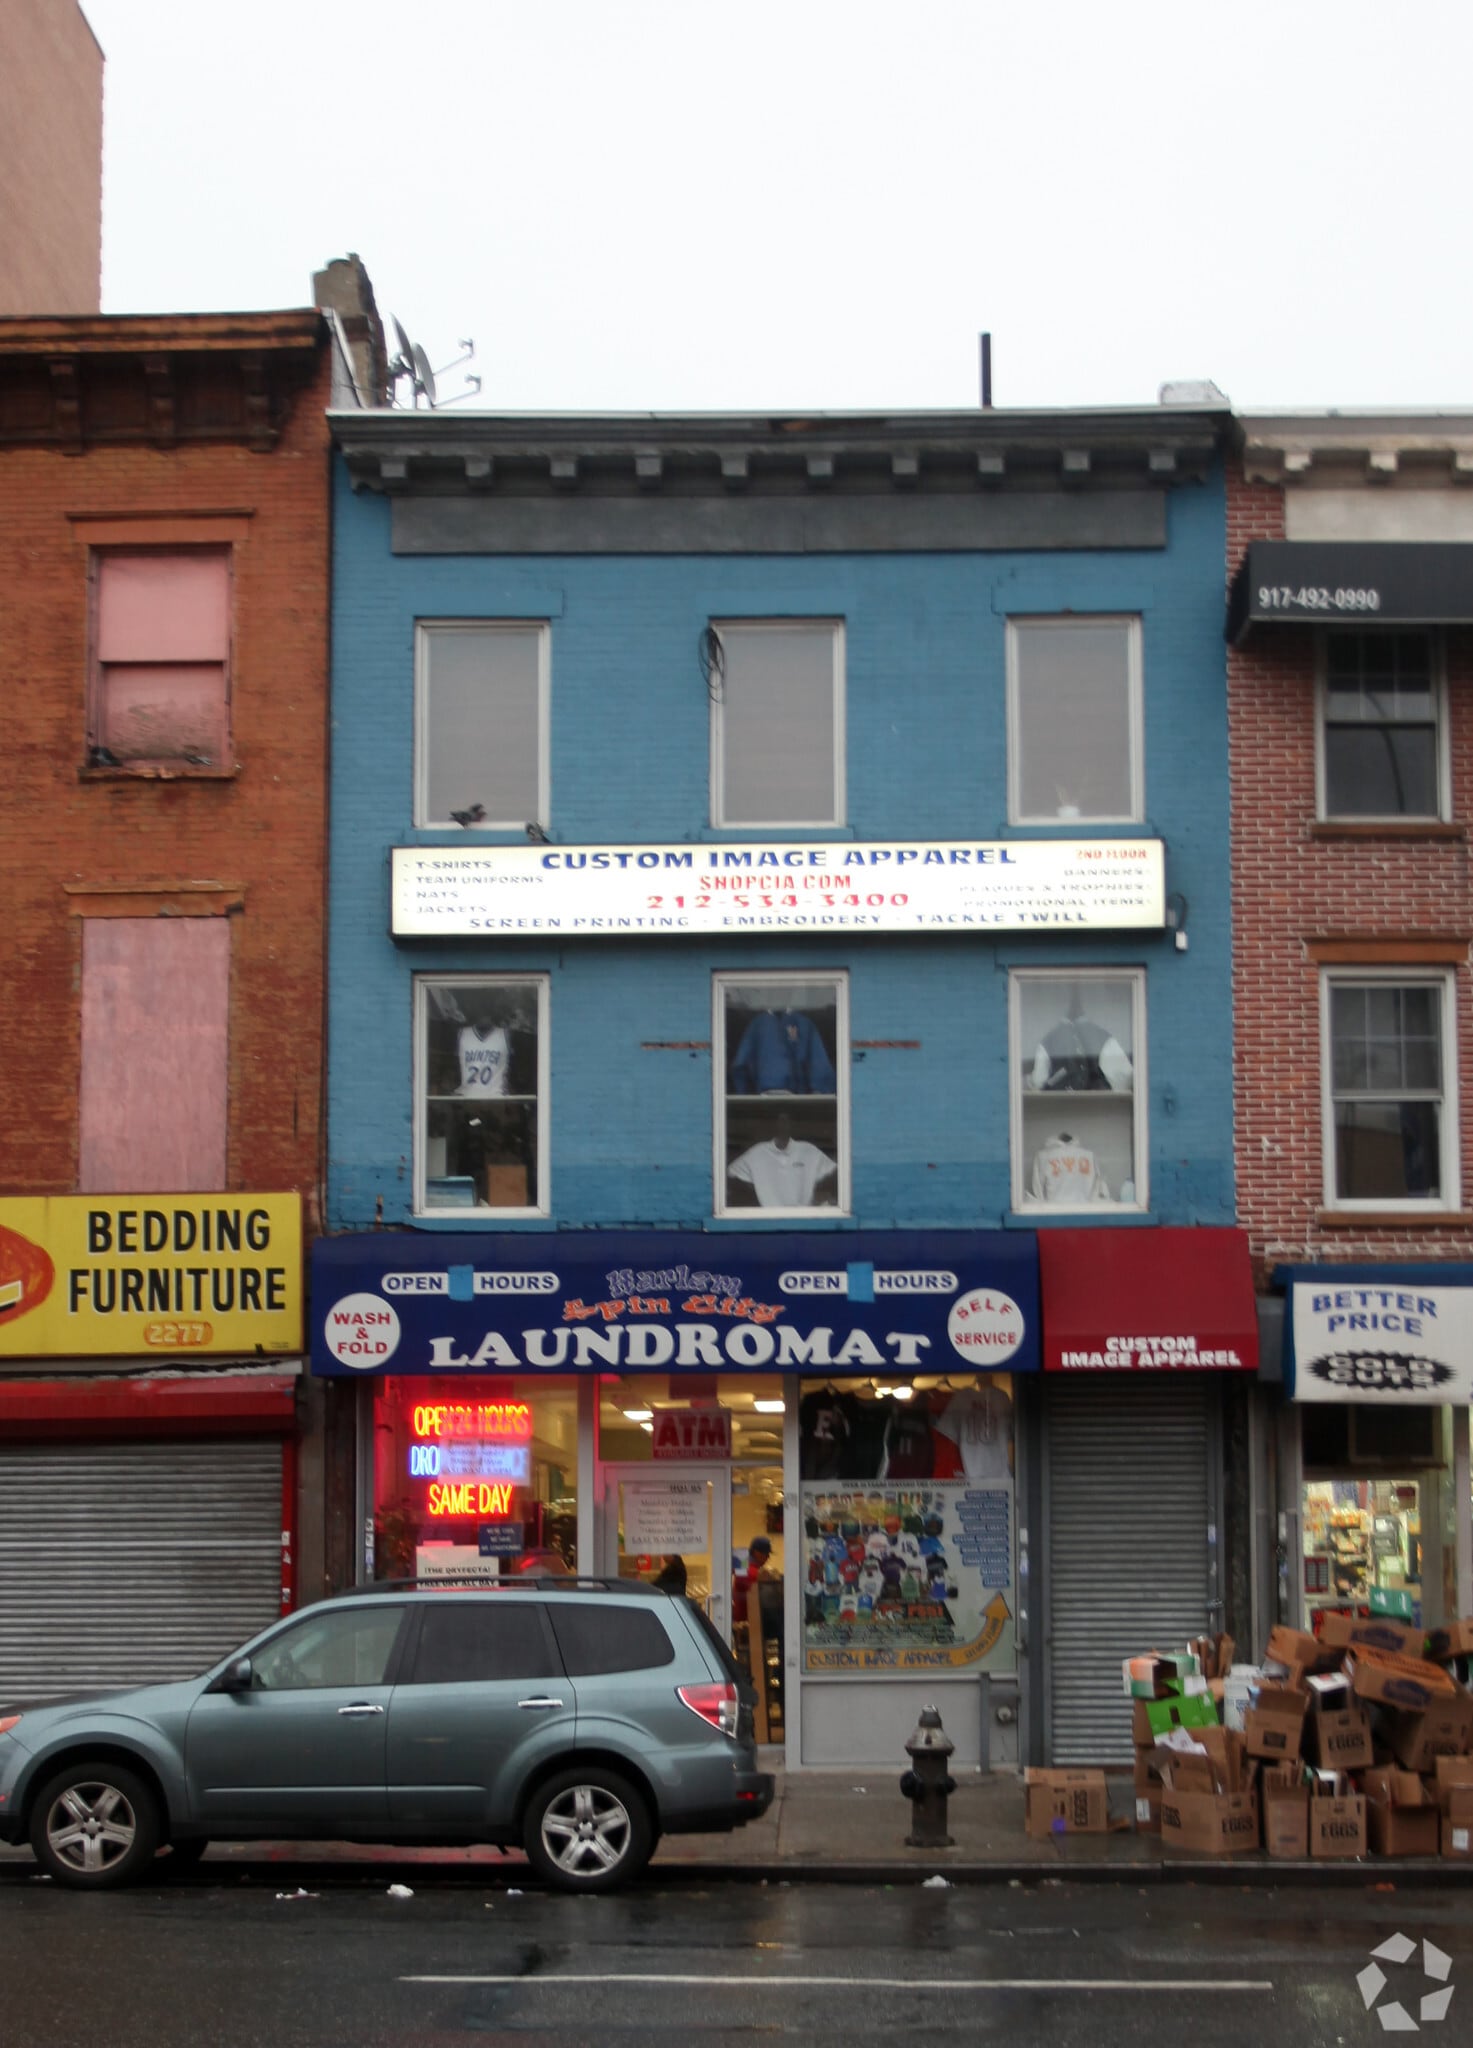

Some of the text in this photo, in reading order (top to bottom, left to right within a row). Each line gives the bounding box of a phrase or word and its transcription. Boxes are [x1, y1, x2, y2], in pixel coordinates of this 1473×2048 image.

[541, 848, 1016, 869] CUSTOM IMAGE APPAREL
[415, 875, 545, 885] TEAM UNIFORMS
[469, 911, 1089, 929] SCREEN PRINTING EMBROIDERY TACKLE TWILL
[467, 1066, 493, 1086] 20
[88, 1208, 271, 1253] BEDDING
[69, 1267, 287, 1313] FURNITURE
[386, 1275, 555, 1290] OPEN HOURS
[605, 1263, 743, 1299] Harlem
[783, 1274, 954, 1289] OPEN HOURS
[681, 1294, 786, 1325] City
[955, 1298, 1013, 1321] SELF
[1312, 1289, 1438, 1319] BETTER
[333, 1312, 391, 1326] WASH
[1327, 1313, 1423, 1337] PRICE
[149, 1324, 206, 1343] 2277
[356, 1327, 369, 1340] &
[955, 1332, 1017, 1346] SERVICE
[337, 1342, 389, 1355] FOLD
[429, 1323, 932, 1367] LAUNDROMAT
[1105, 1336, 1196, 1351] CUSTOM
[1061, 1350, 1242, 1368] IMAGE APPAREL
[657, 1415, 727, 1447] ATM
[428, 1483, 513, 1516] SAME DAY
[1327, 1733, 1365, 1751] EGGS
[1221, 1815, 1254, 1834] EGGS
[1320, 1822, 1359, 1840] EGGS
